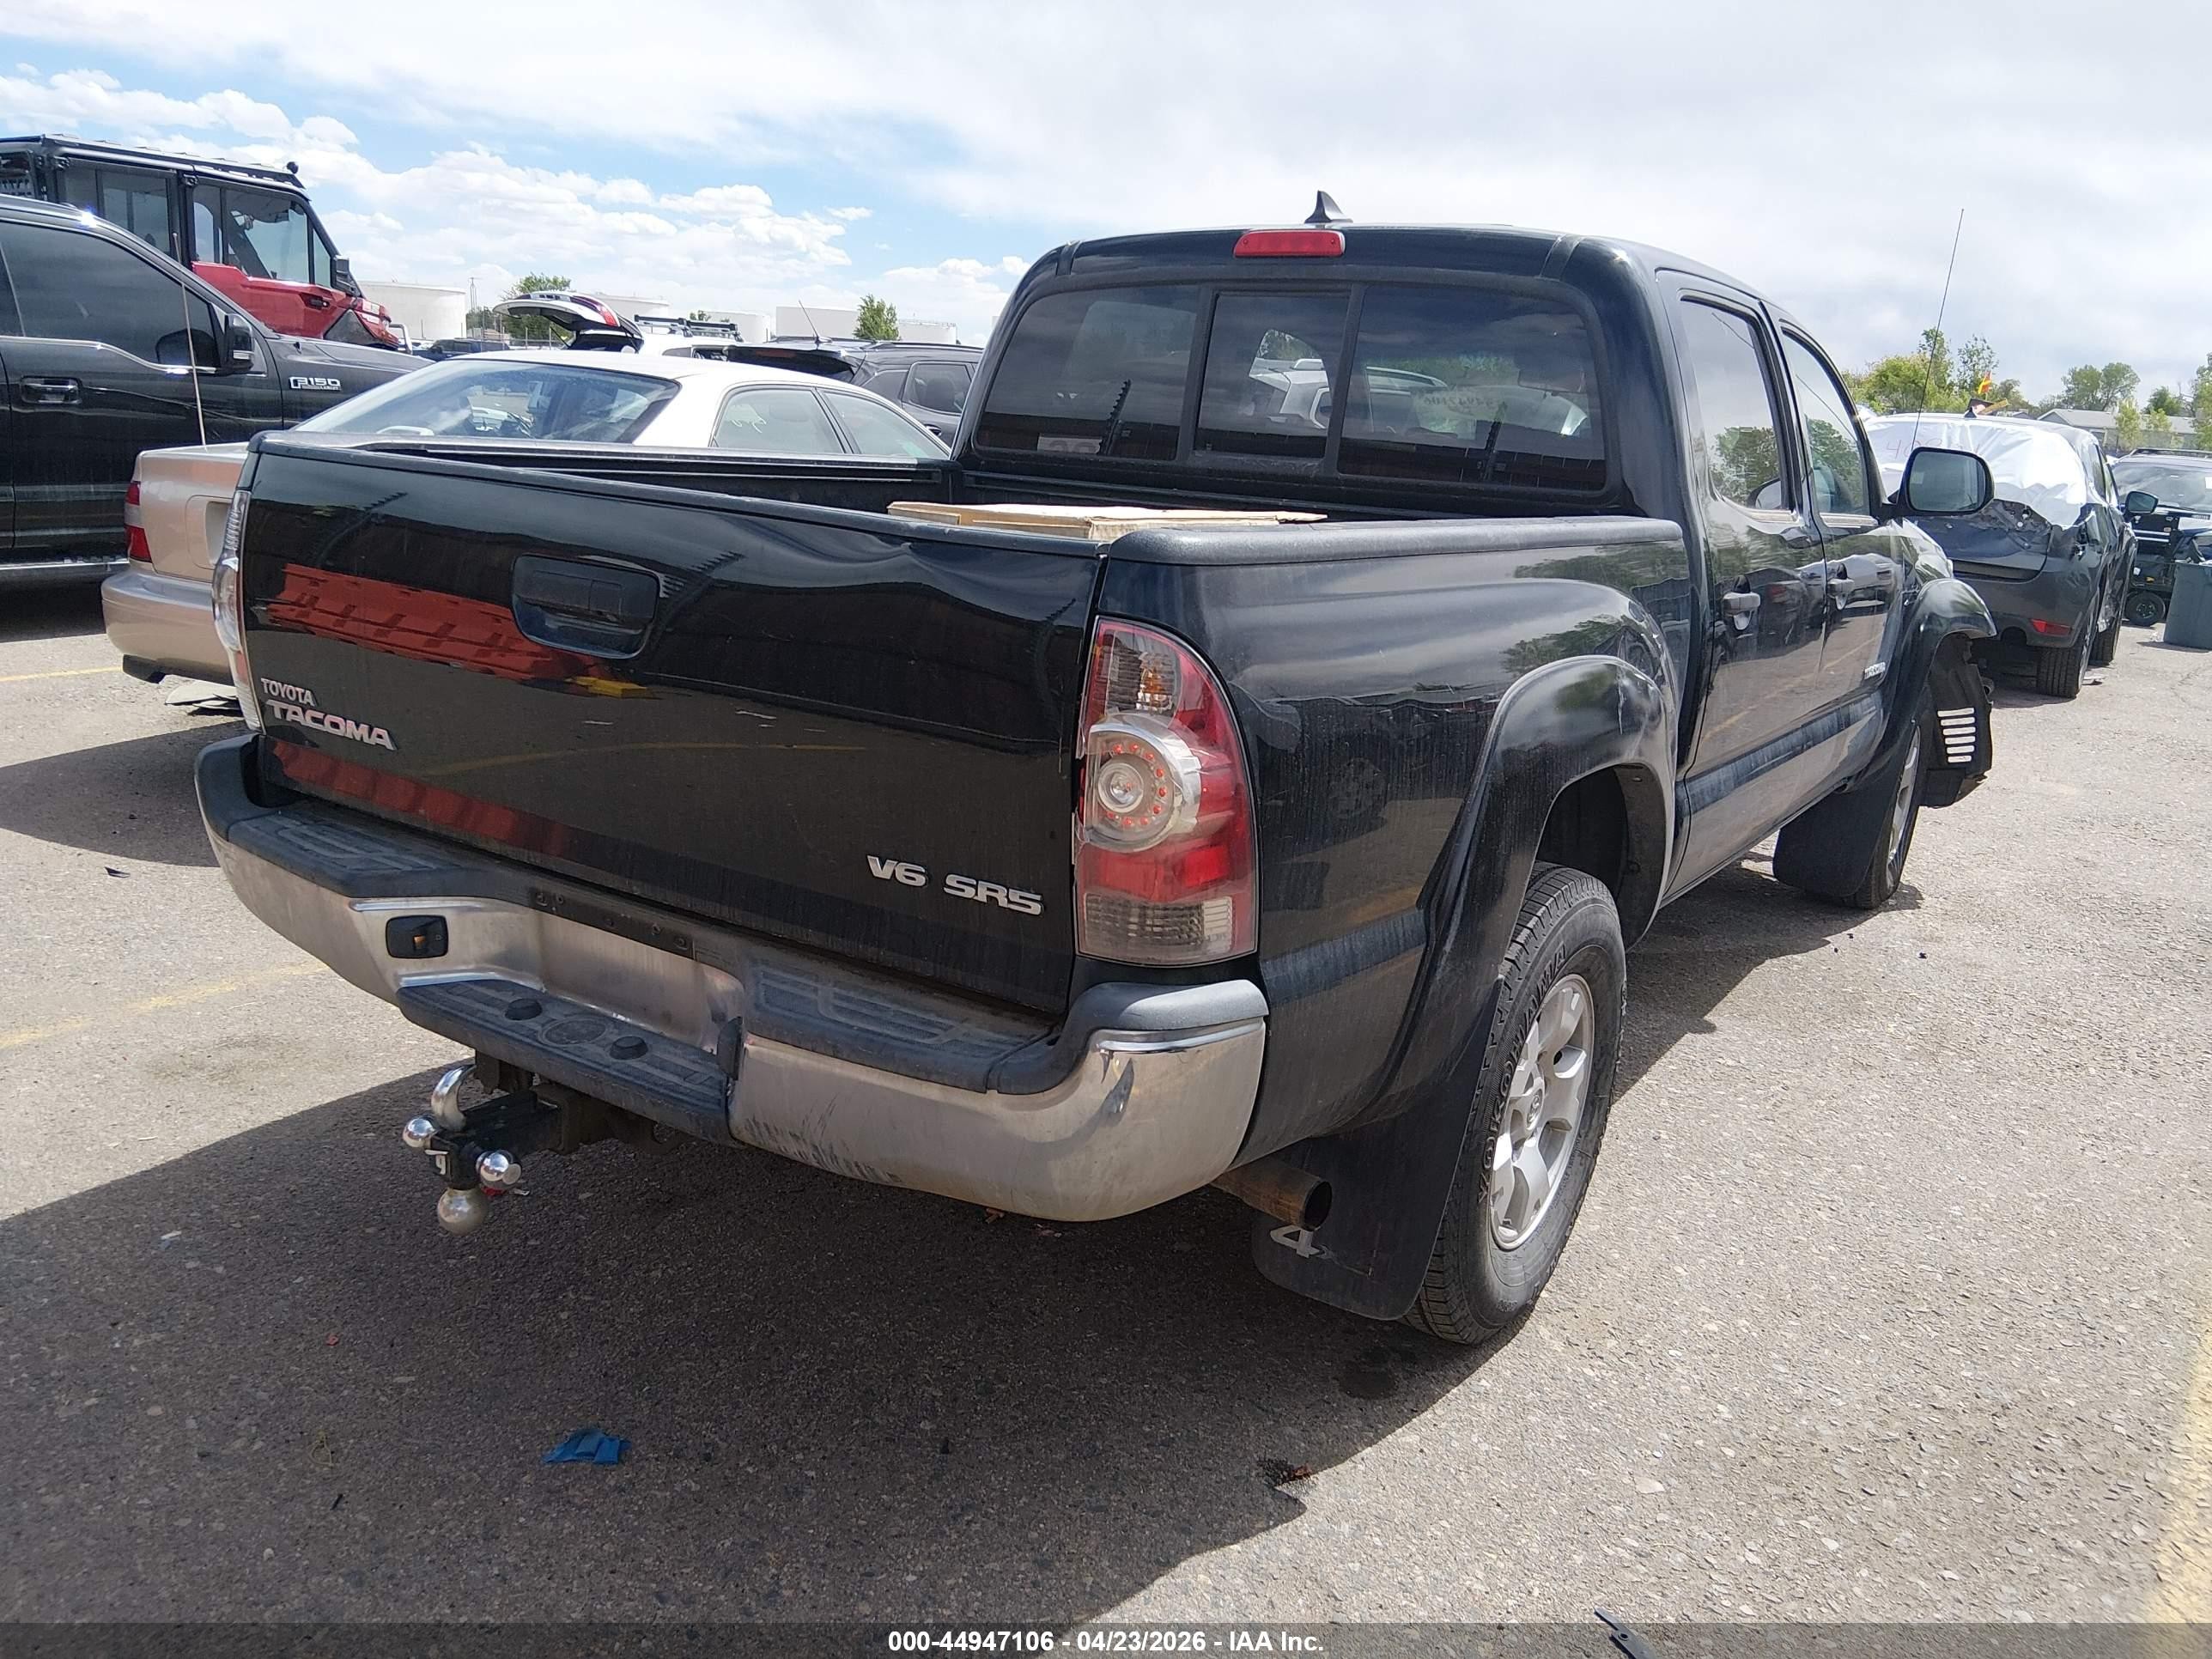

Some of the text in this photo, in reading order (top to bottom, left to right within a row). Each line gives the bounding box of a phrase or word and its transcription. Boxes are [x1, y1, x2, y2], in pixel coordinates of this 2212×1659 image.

[260, 678, 315, 707] TOYOTA
[265, 698, 397, 750] TACOMA
[866, 855, 1042, 915] V6 SR5
